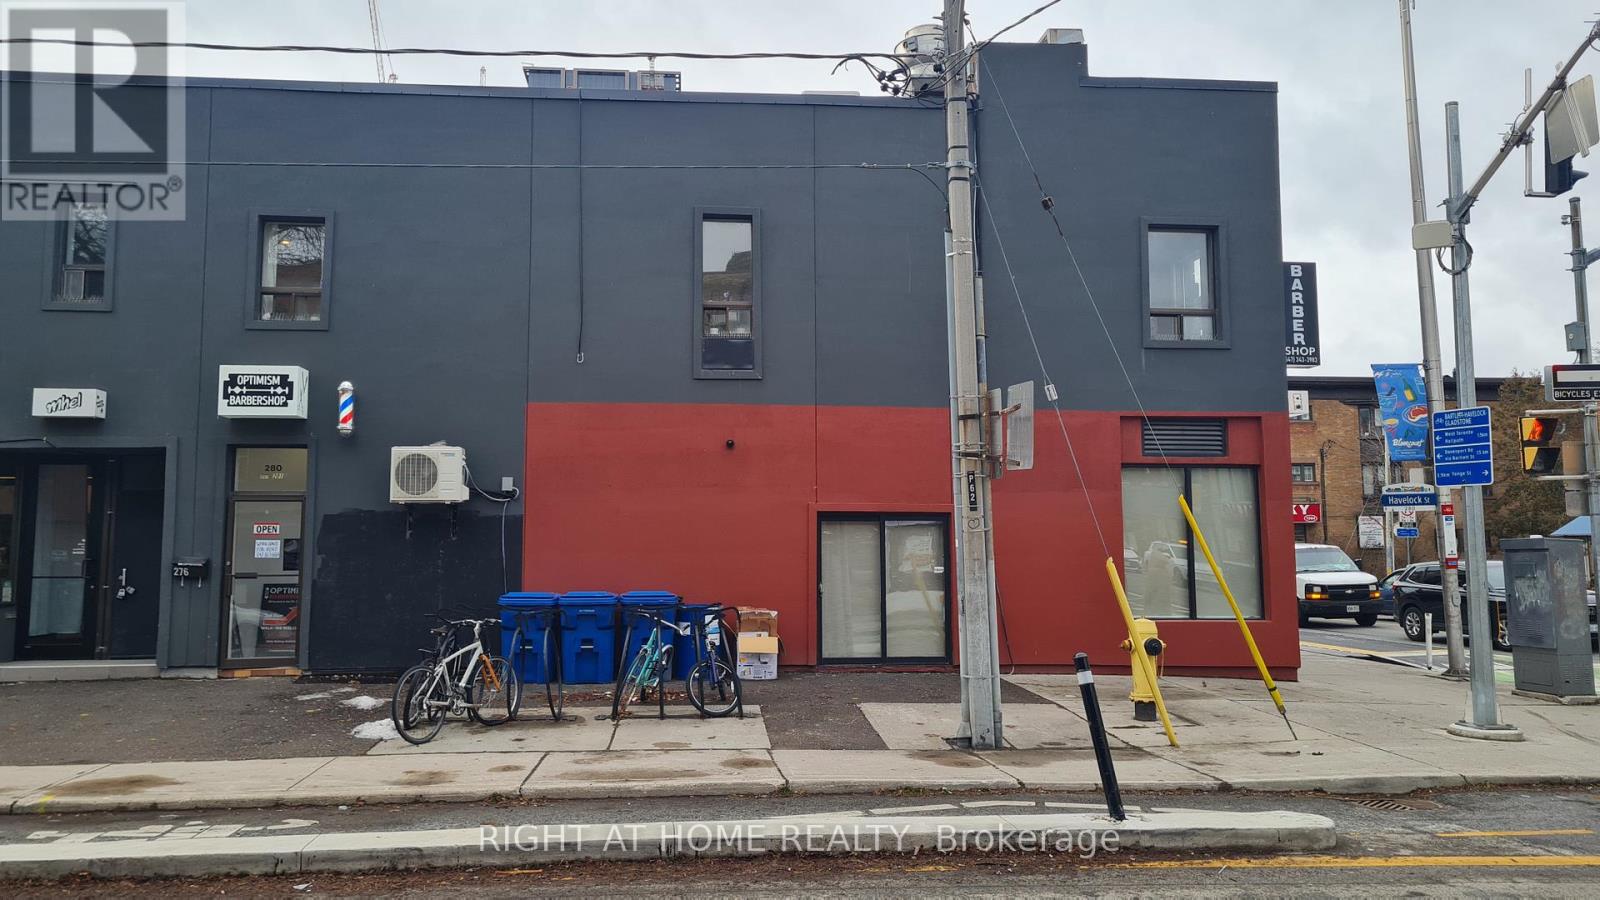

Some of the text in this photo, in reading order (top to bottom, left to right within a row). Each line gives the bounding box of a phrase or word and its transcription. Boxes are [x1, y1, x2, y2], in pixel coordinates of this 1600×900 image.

[1290, 264, 1305, 346] BARBER
[1285, 346, 1316, 356] SHOP
[237, 375, 280, 386] OPTIMISM
[1554, 390, 1591, 398] BICYCLES
[46, 391, 83, 414] mhel
[229, 395, 287, 406] BARBERSHOP
[1444, 417, 1472, 427] GLADSTONE
[264, 464, 283, 472] 280
[1388, 495, 1423, 505] Havelock
[255, 525, 278, 534] OPEN
[173, 567, 190, 577] 276
